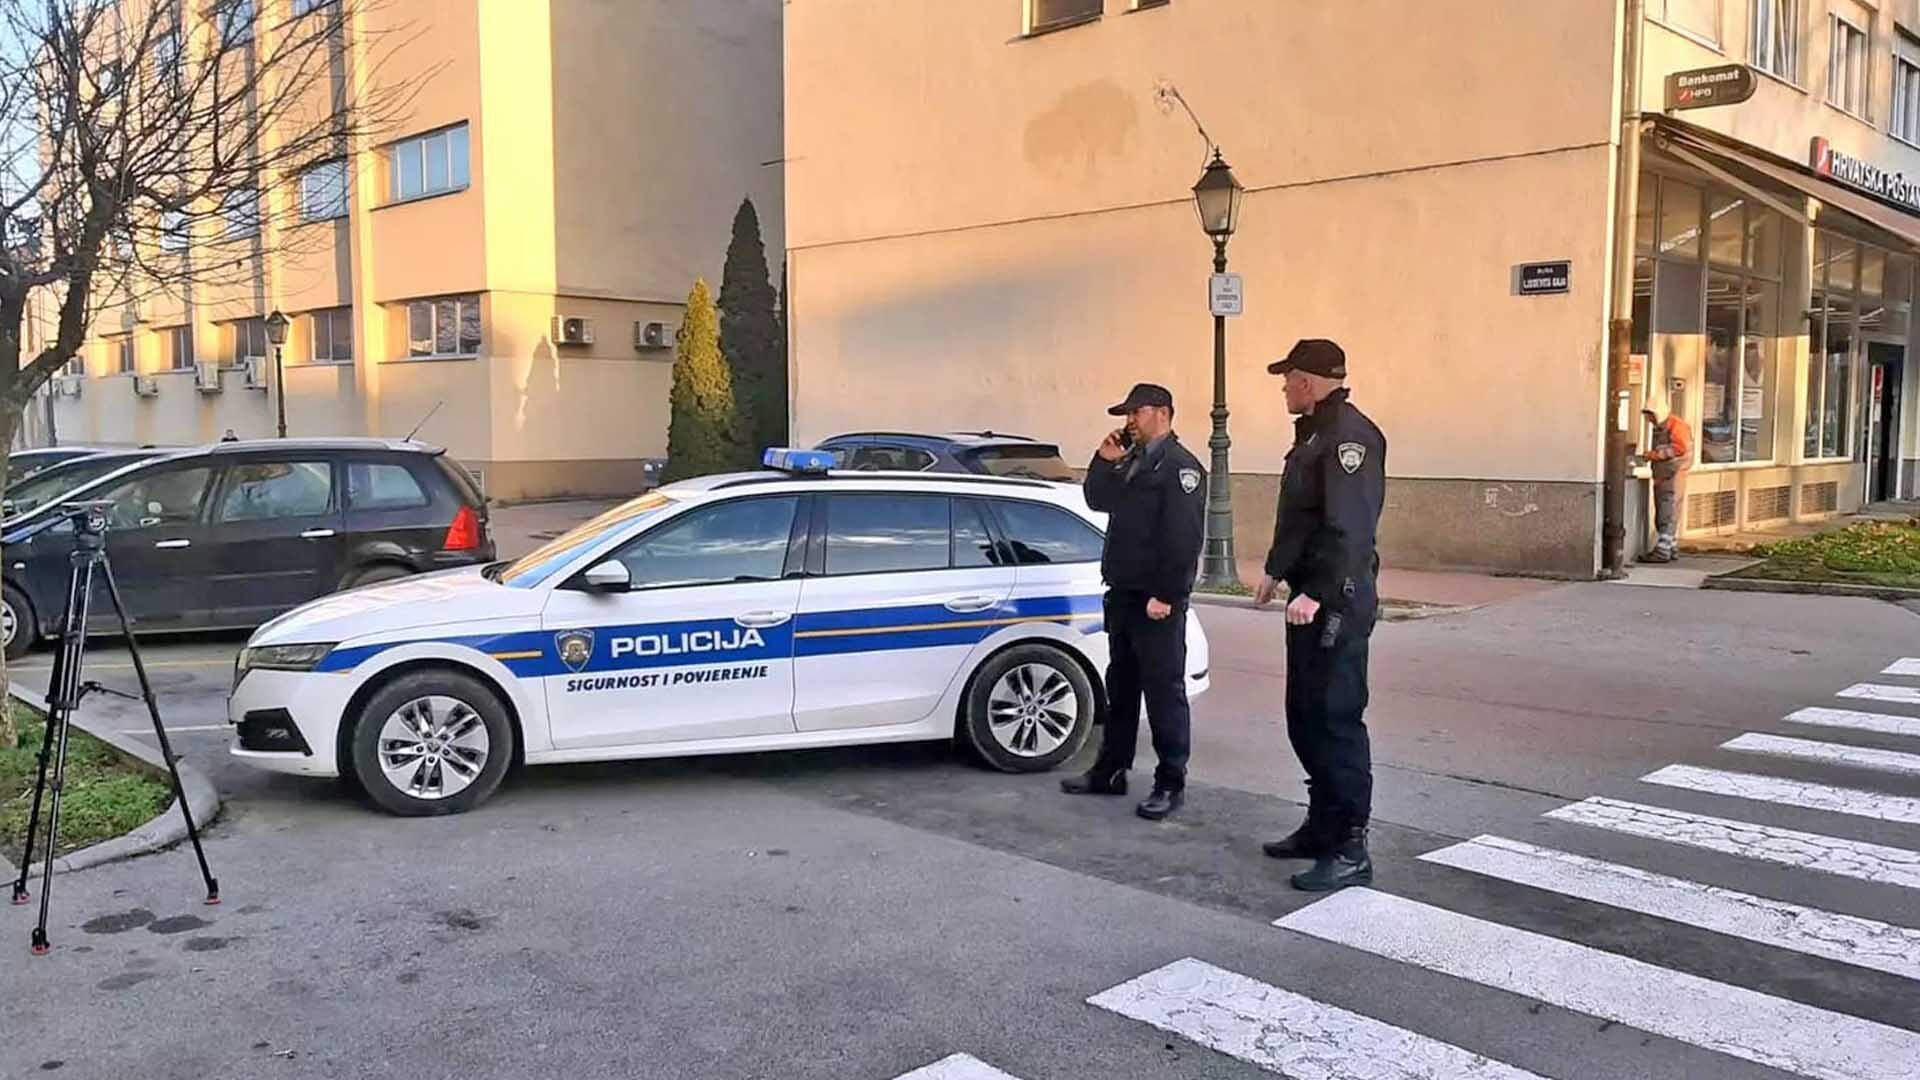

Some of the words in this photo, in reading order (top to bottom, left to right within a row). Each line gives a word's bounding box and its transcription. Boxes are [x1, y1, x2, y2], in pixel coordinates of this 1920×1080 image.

[1678, 69, 1740, 87] Bankomat
[1832, 151, 1884, 195] HRVATSKA
[611, 628, 765, 658] POLICIJA
[567, 674, 660, 692] SIGURNOST
[663, 674, 669, 686] I
[673, 665, 769, 685] POVJERENJE
